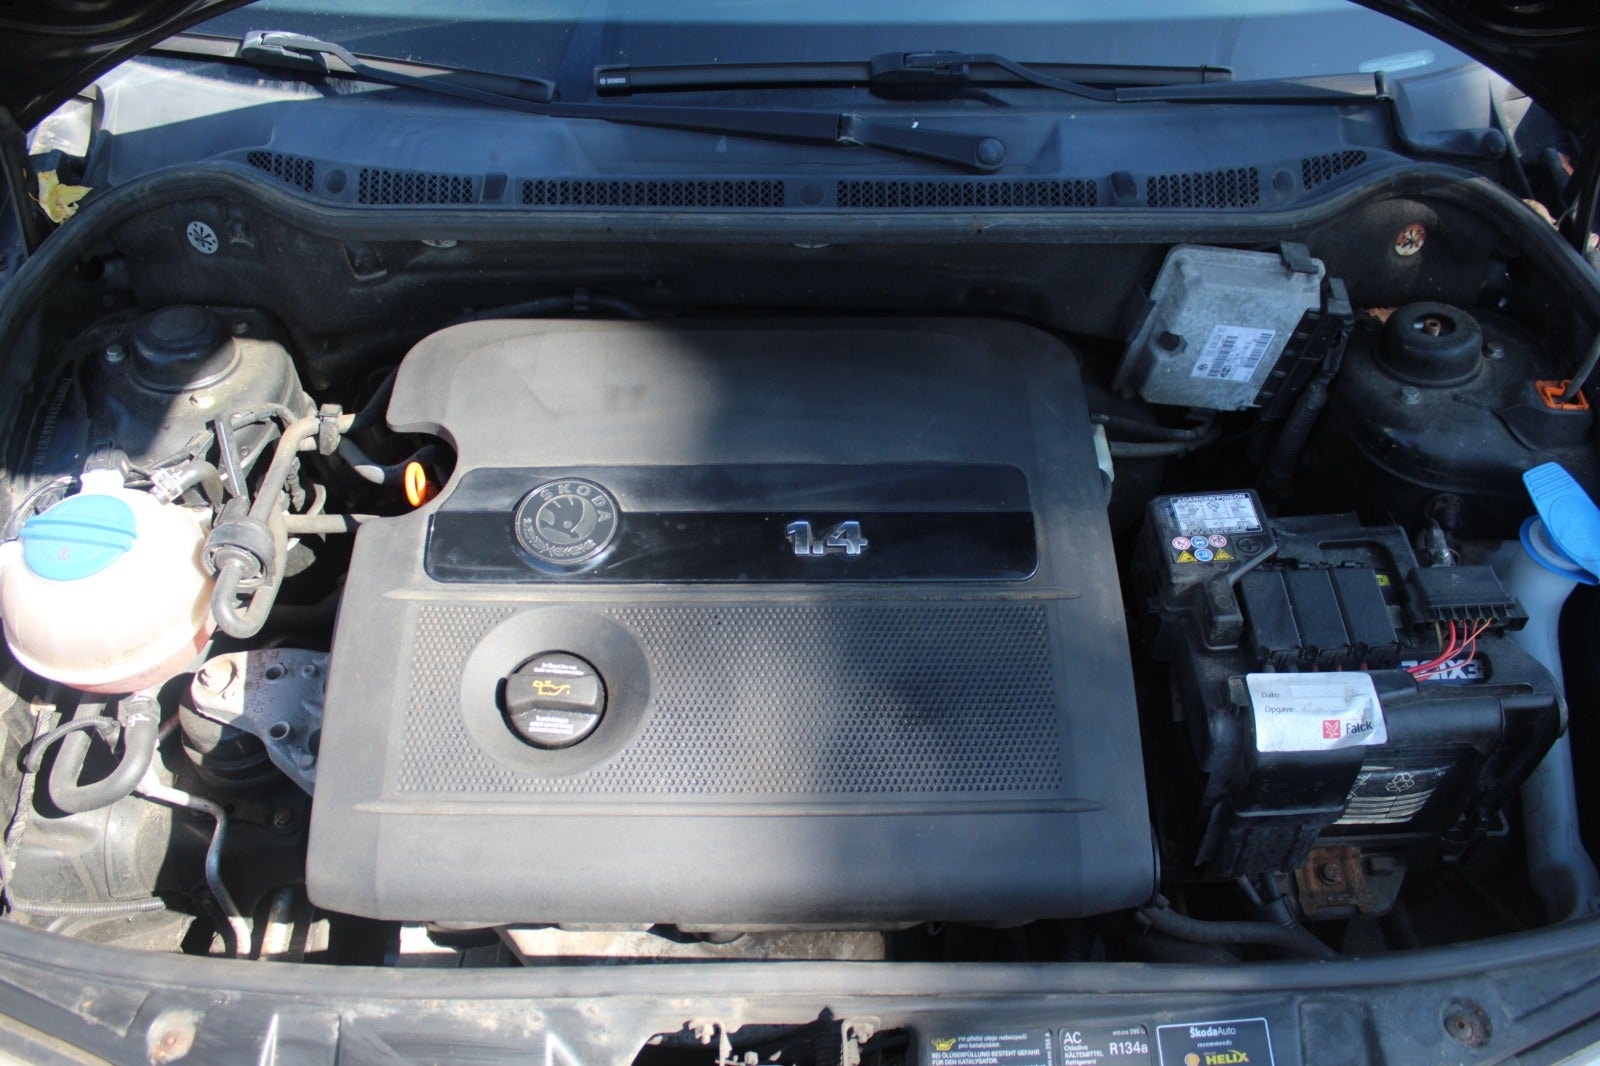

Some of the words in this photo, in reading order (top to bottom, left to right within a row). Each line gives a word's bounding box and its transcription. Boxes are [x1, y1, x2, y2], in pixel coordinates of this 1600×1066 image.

[786, 520, 868, 555] 1.4
[1400, 659, 1485, 681] EXI
[1260, 691, 1281, 700] Dato
[1264, 706, 1295, 715] Opgave
[1345, 721, 1374, 735] Falck
[1063, 1031, 1082, 1045] AC
[1109, 1041, 1148, 1056] R134a
[1206, 1051, 1249, 1065] HELIX
